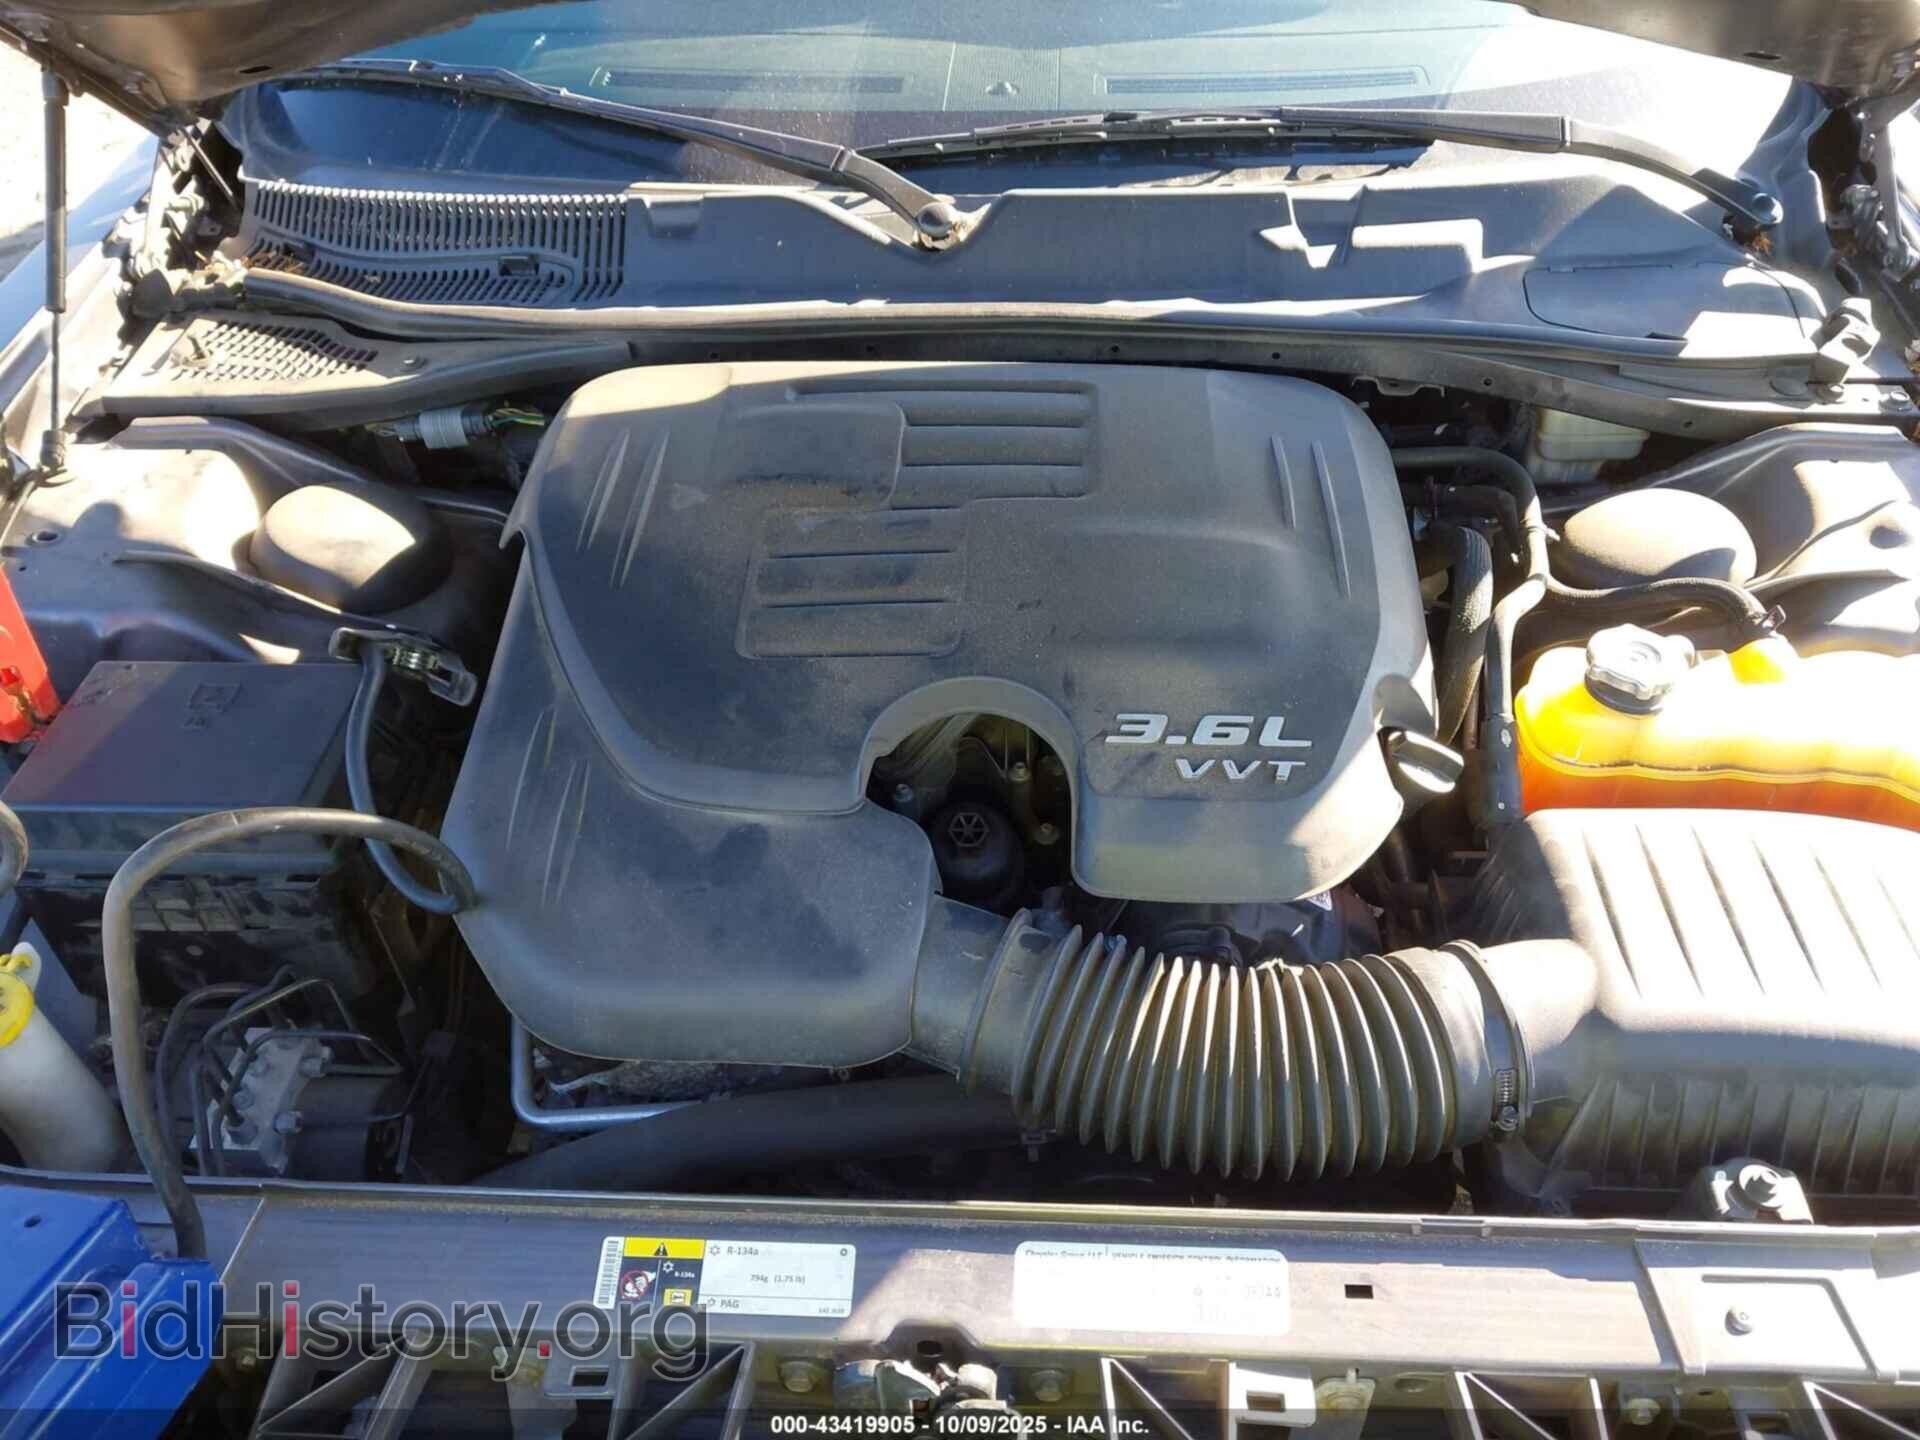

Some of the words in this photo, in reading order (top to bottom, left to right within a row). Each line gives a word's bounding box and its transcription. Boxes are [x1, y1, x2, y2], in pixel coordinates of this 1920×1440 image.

[1105, 714, 1312, 747] 3.6L
[1175, 758, 1307, 783] VVT
[726, 1246, 760, 1257] R-134a
[720, 1299, 741, 1310] PAG
